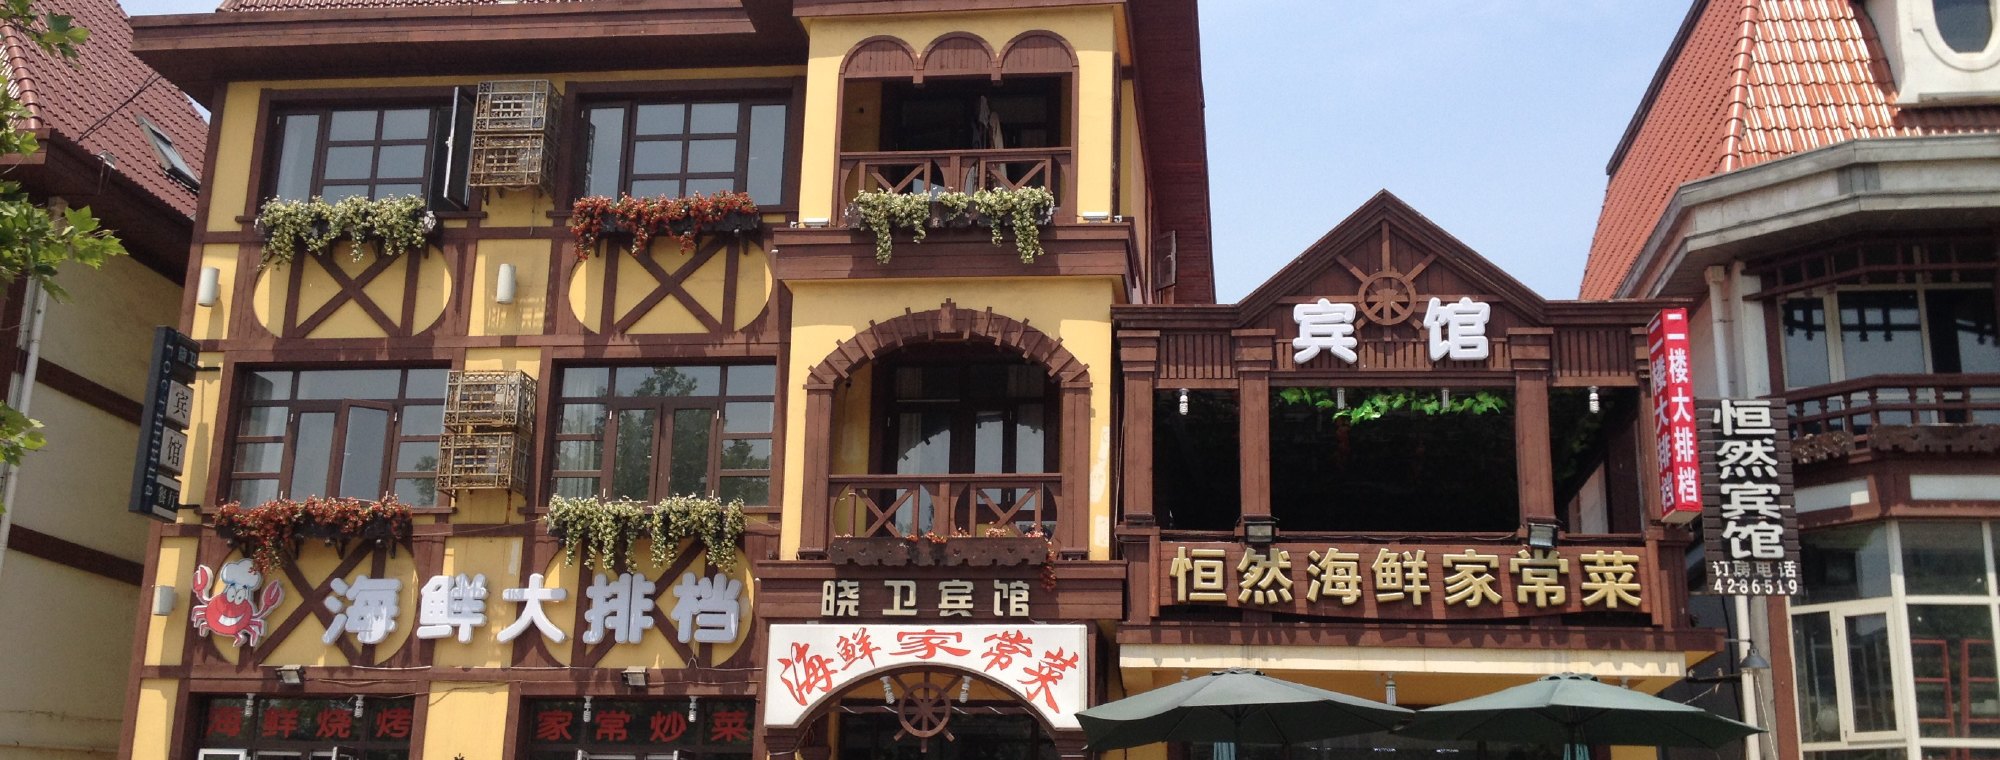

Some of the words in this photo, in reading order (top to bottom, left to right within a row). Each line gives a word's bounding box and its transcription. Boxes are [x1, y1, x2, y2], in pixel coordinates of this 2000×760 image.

[1293, 297, 1490, 364] 宾馆
[168, 389, 189, 467] 宾馆
[1650, 319, 1674, 512] 二楼大排档
[1667, 314, 1698, 503] 二楼大排档
[1713, 399, 1785, 559] 恒然宾馆
[820, 579, 1030, 617] 晓卫宾馆
[1170, 546, 1641, 608] 恒然海鲜家常菜
[1713, 560, 1797, 578] 订房电话
[1714, 578, 1798, 595] 4286519
[322, 572, 744, 645] 海鲜大排档
[777, 626, 1080, 714] 海鲜家常菜
[207, 706, 413, 738] 海鲜烧烤
[536, 709, 749, 742] 家常炒菜
